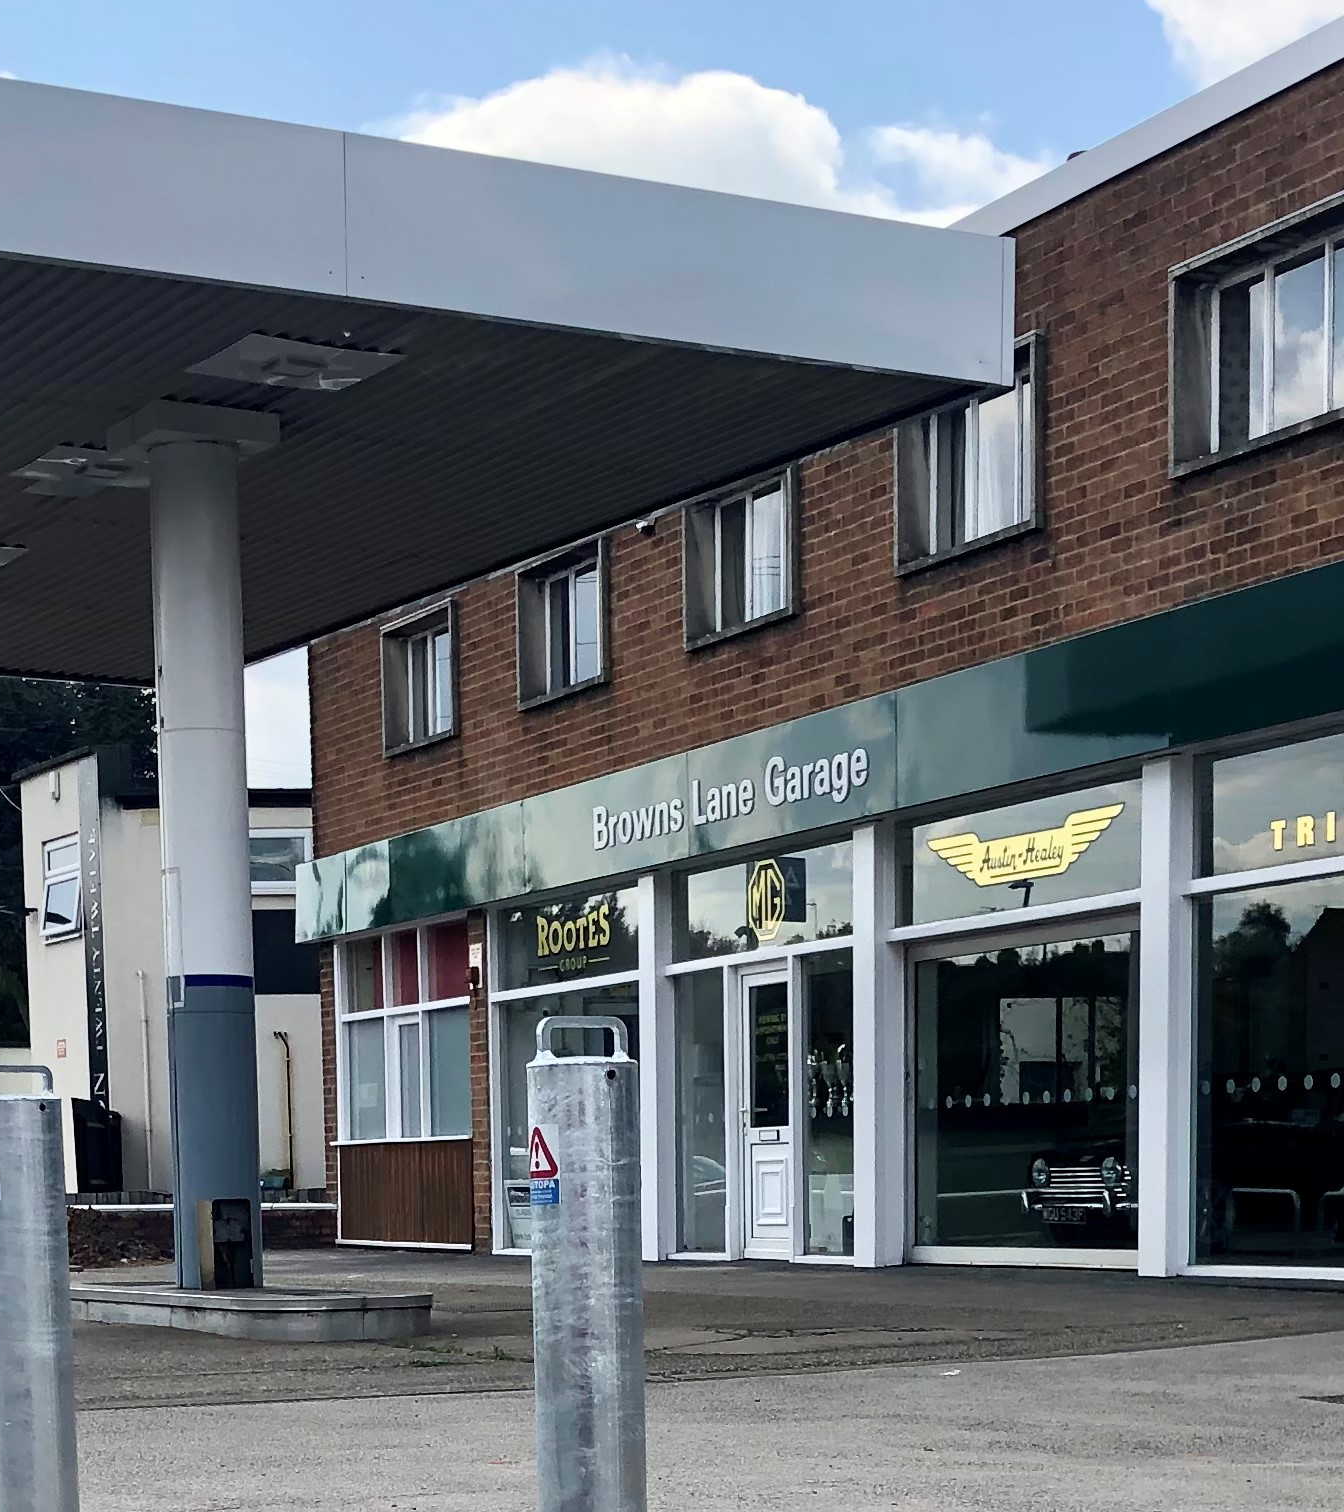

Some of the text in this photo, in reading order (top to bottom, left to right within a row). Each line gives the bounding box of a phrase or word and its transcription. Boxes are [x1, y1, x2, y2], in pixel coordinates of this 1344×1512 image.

[592, 748, 869, 851] Browns Lane Garage
[979, 835, 1065, 873] Austin-Healey
[752, 867, 782, 931] MG
[537, 902, 611, 957] ROOTES
[559, 955, 588, 973] GROUP
